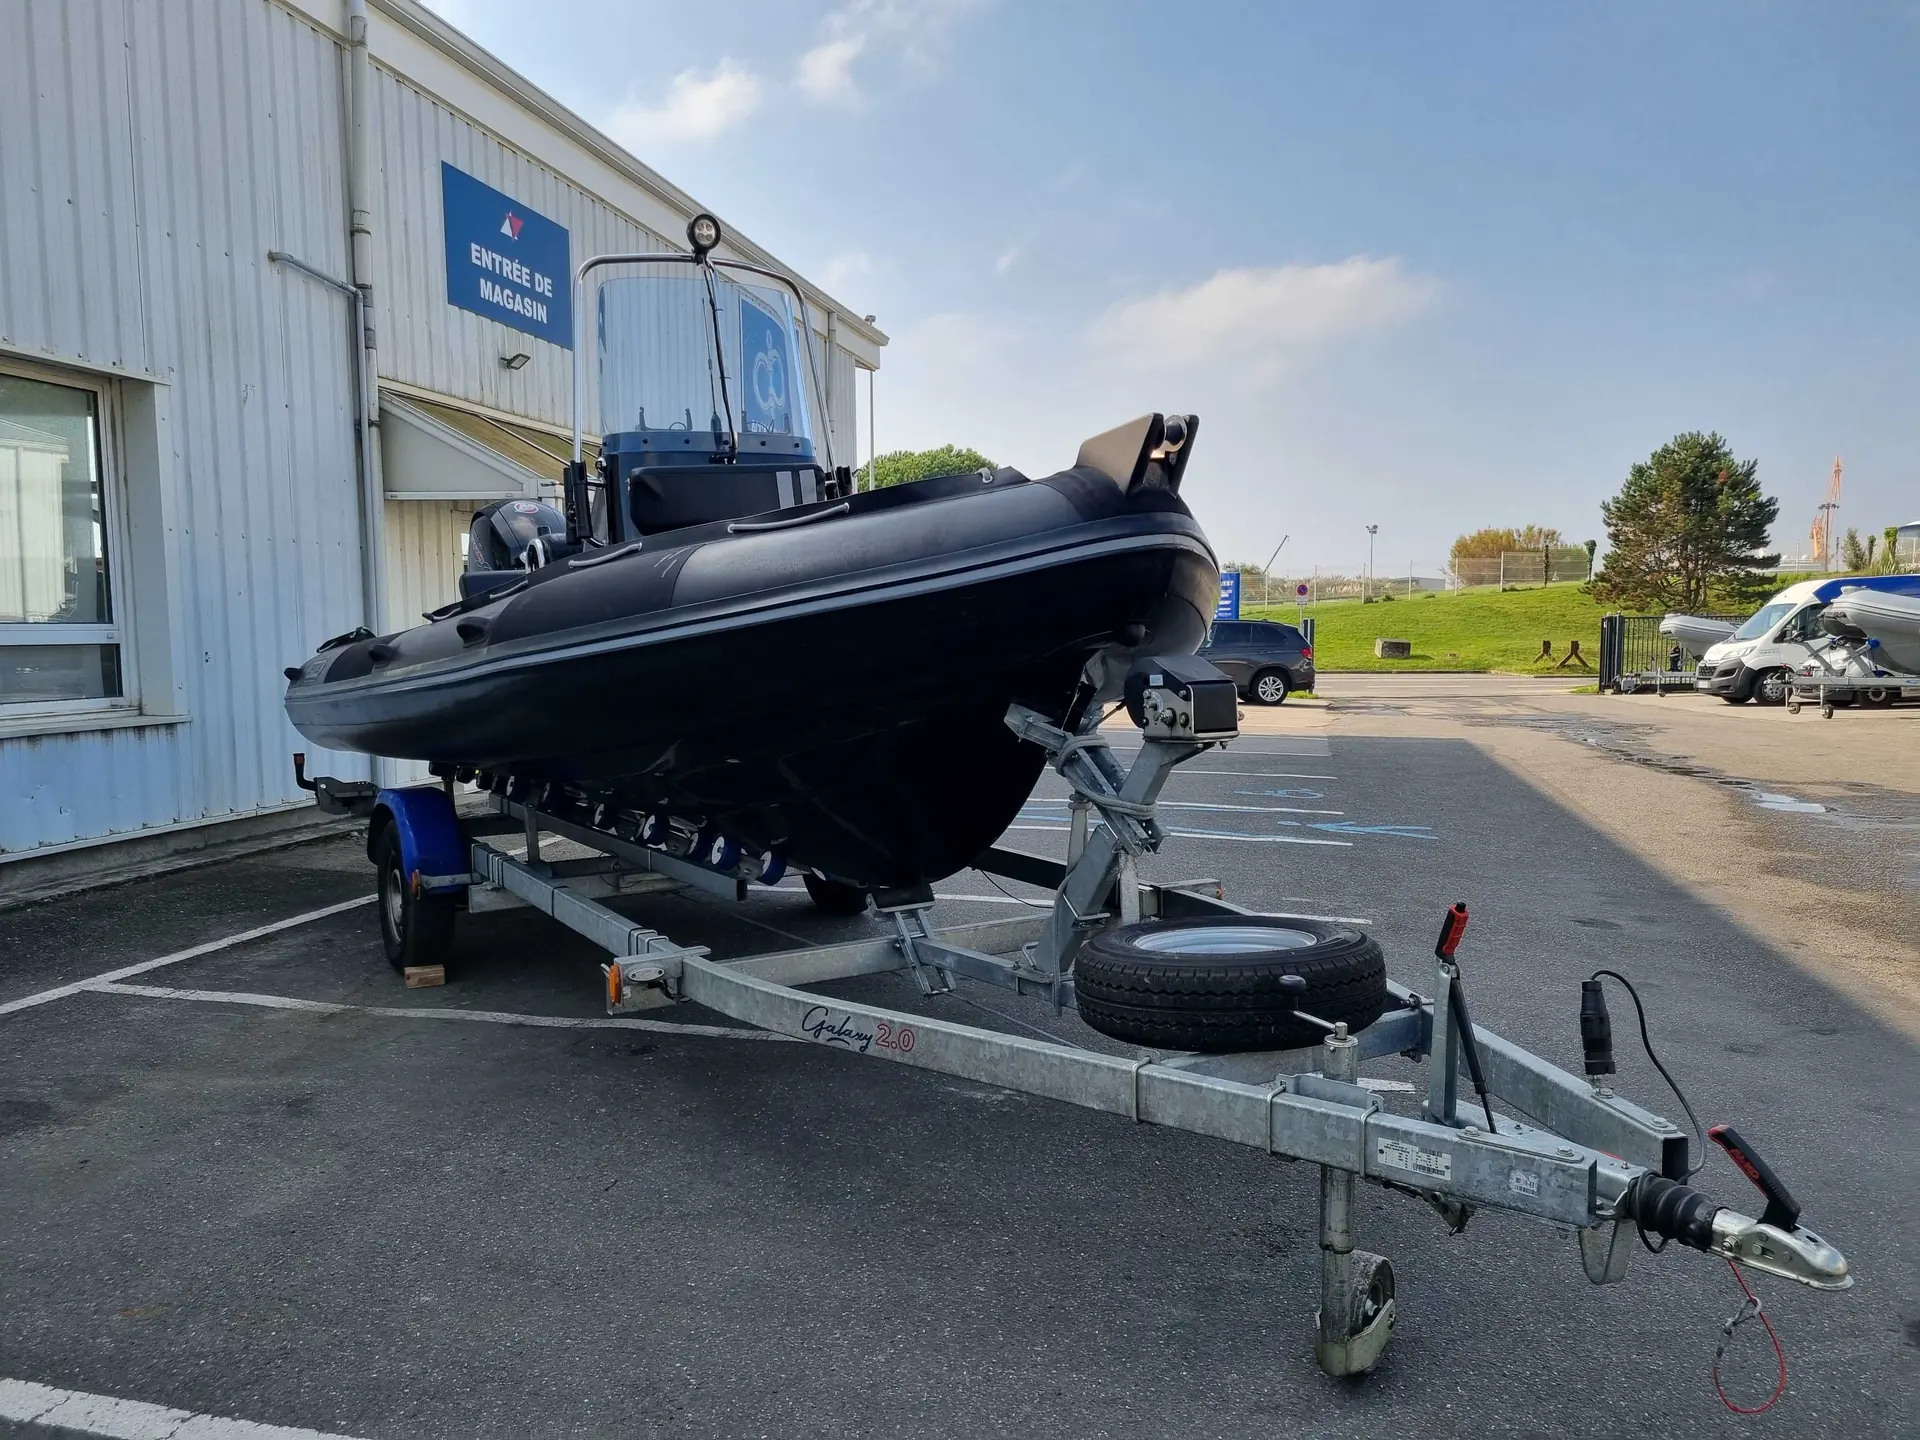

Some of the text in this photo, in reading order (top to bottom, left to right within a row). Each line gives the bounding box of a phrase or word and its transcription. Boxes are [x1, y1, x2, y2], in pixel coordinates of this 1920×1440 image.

[470, 242, 553, 298] ENTRÉE DE
[479, 278, 548, 325] MAGASIN
[802, 1006, 915, 1052] Galaxy 2.0
